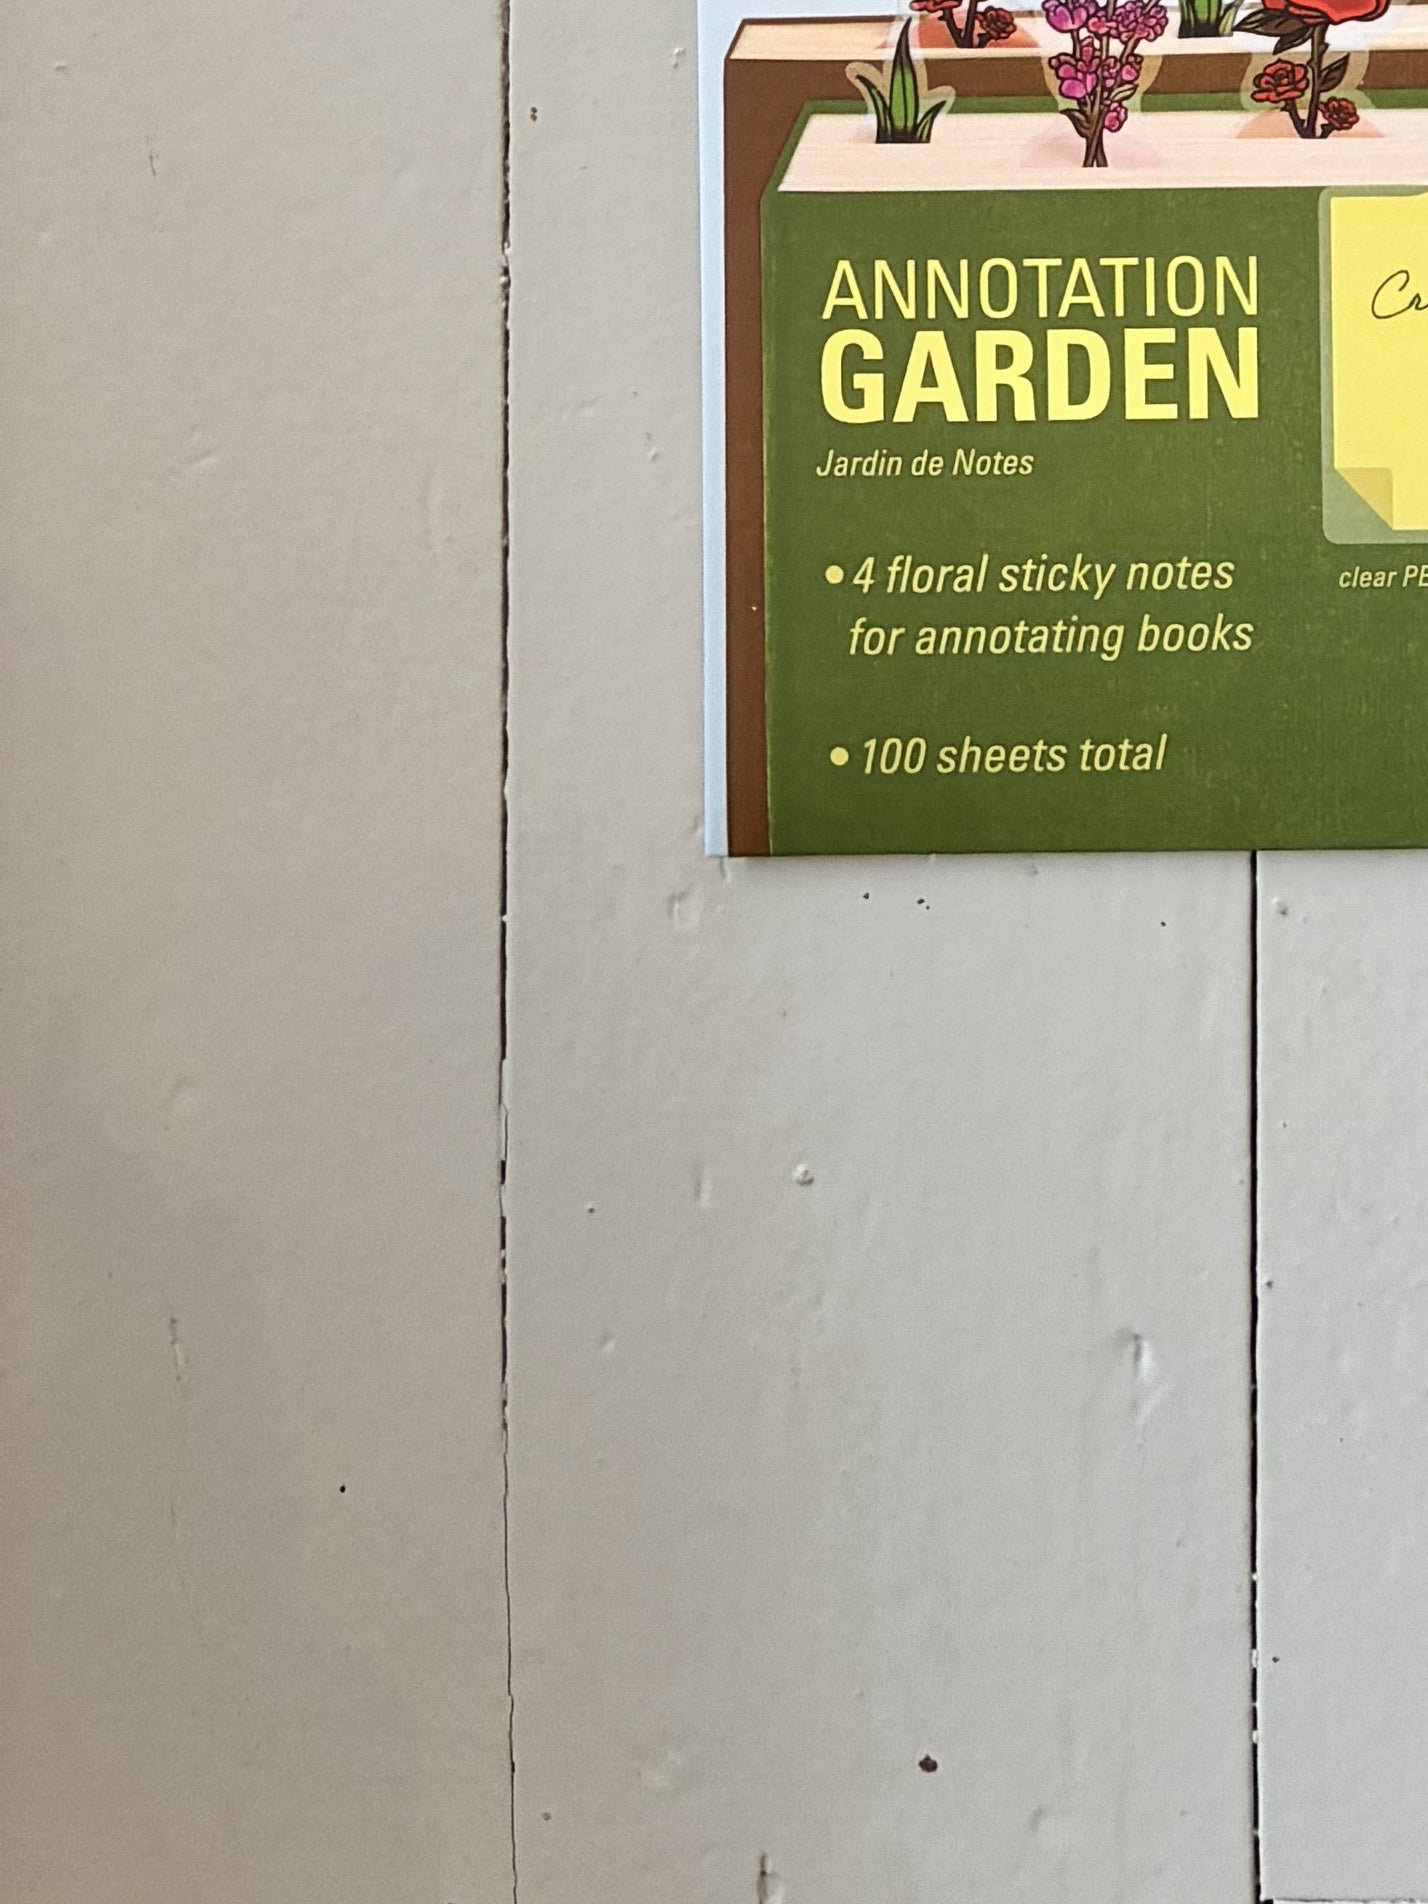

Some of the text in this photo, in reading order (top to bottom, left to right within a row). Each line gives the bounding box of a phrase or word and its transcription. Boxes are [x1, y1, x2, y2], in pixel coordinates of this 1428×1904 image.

[822, 256, 1257, 319] ANNOTATION
[822, 327, 1258, 423] GARDEN
[817, 449, 1033, 476] Jardin de Notes
[853, 553, 1234, 600] 4 floral sticky notes
[1339, 567, 1397, 587] clear
[850, 613, 1253, 661] for annotating books
[865, 734, 1167, 773] 100 sheets total
